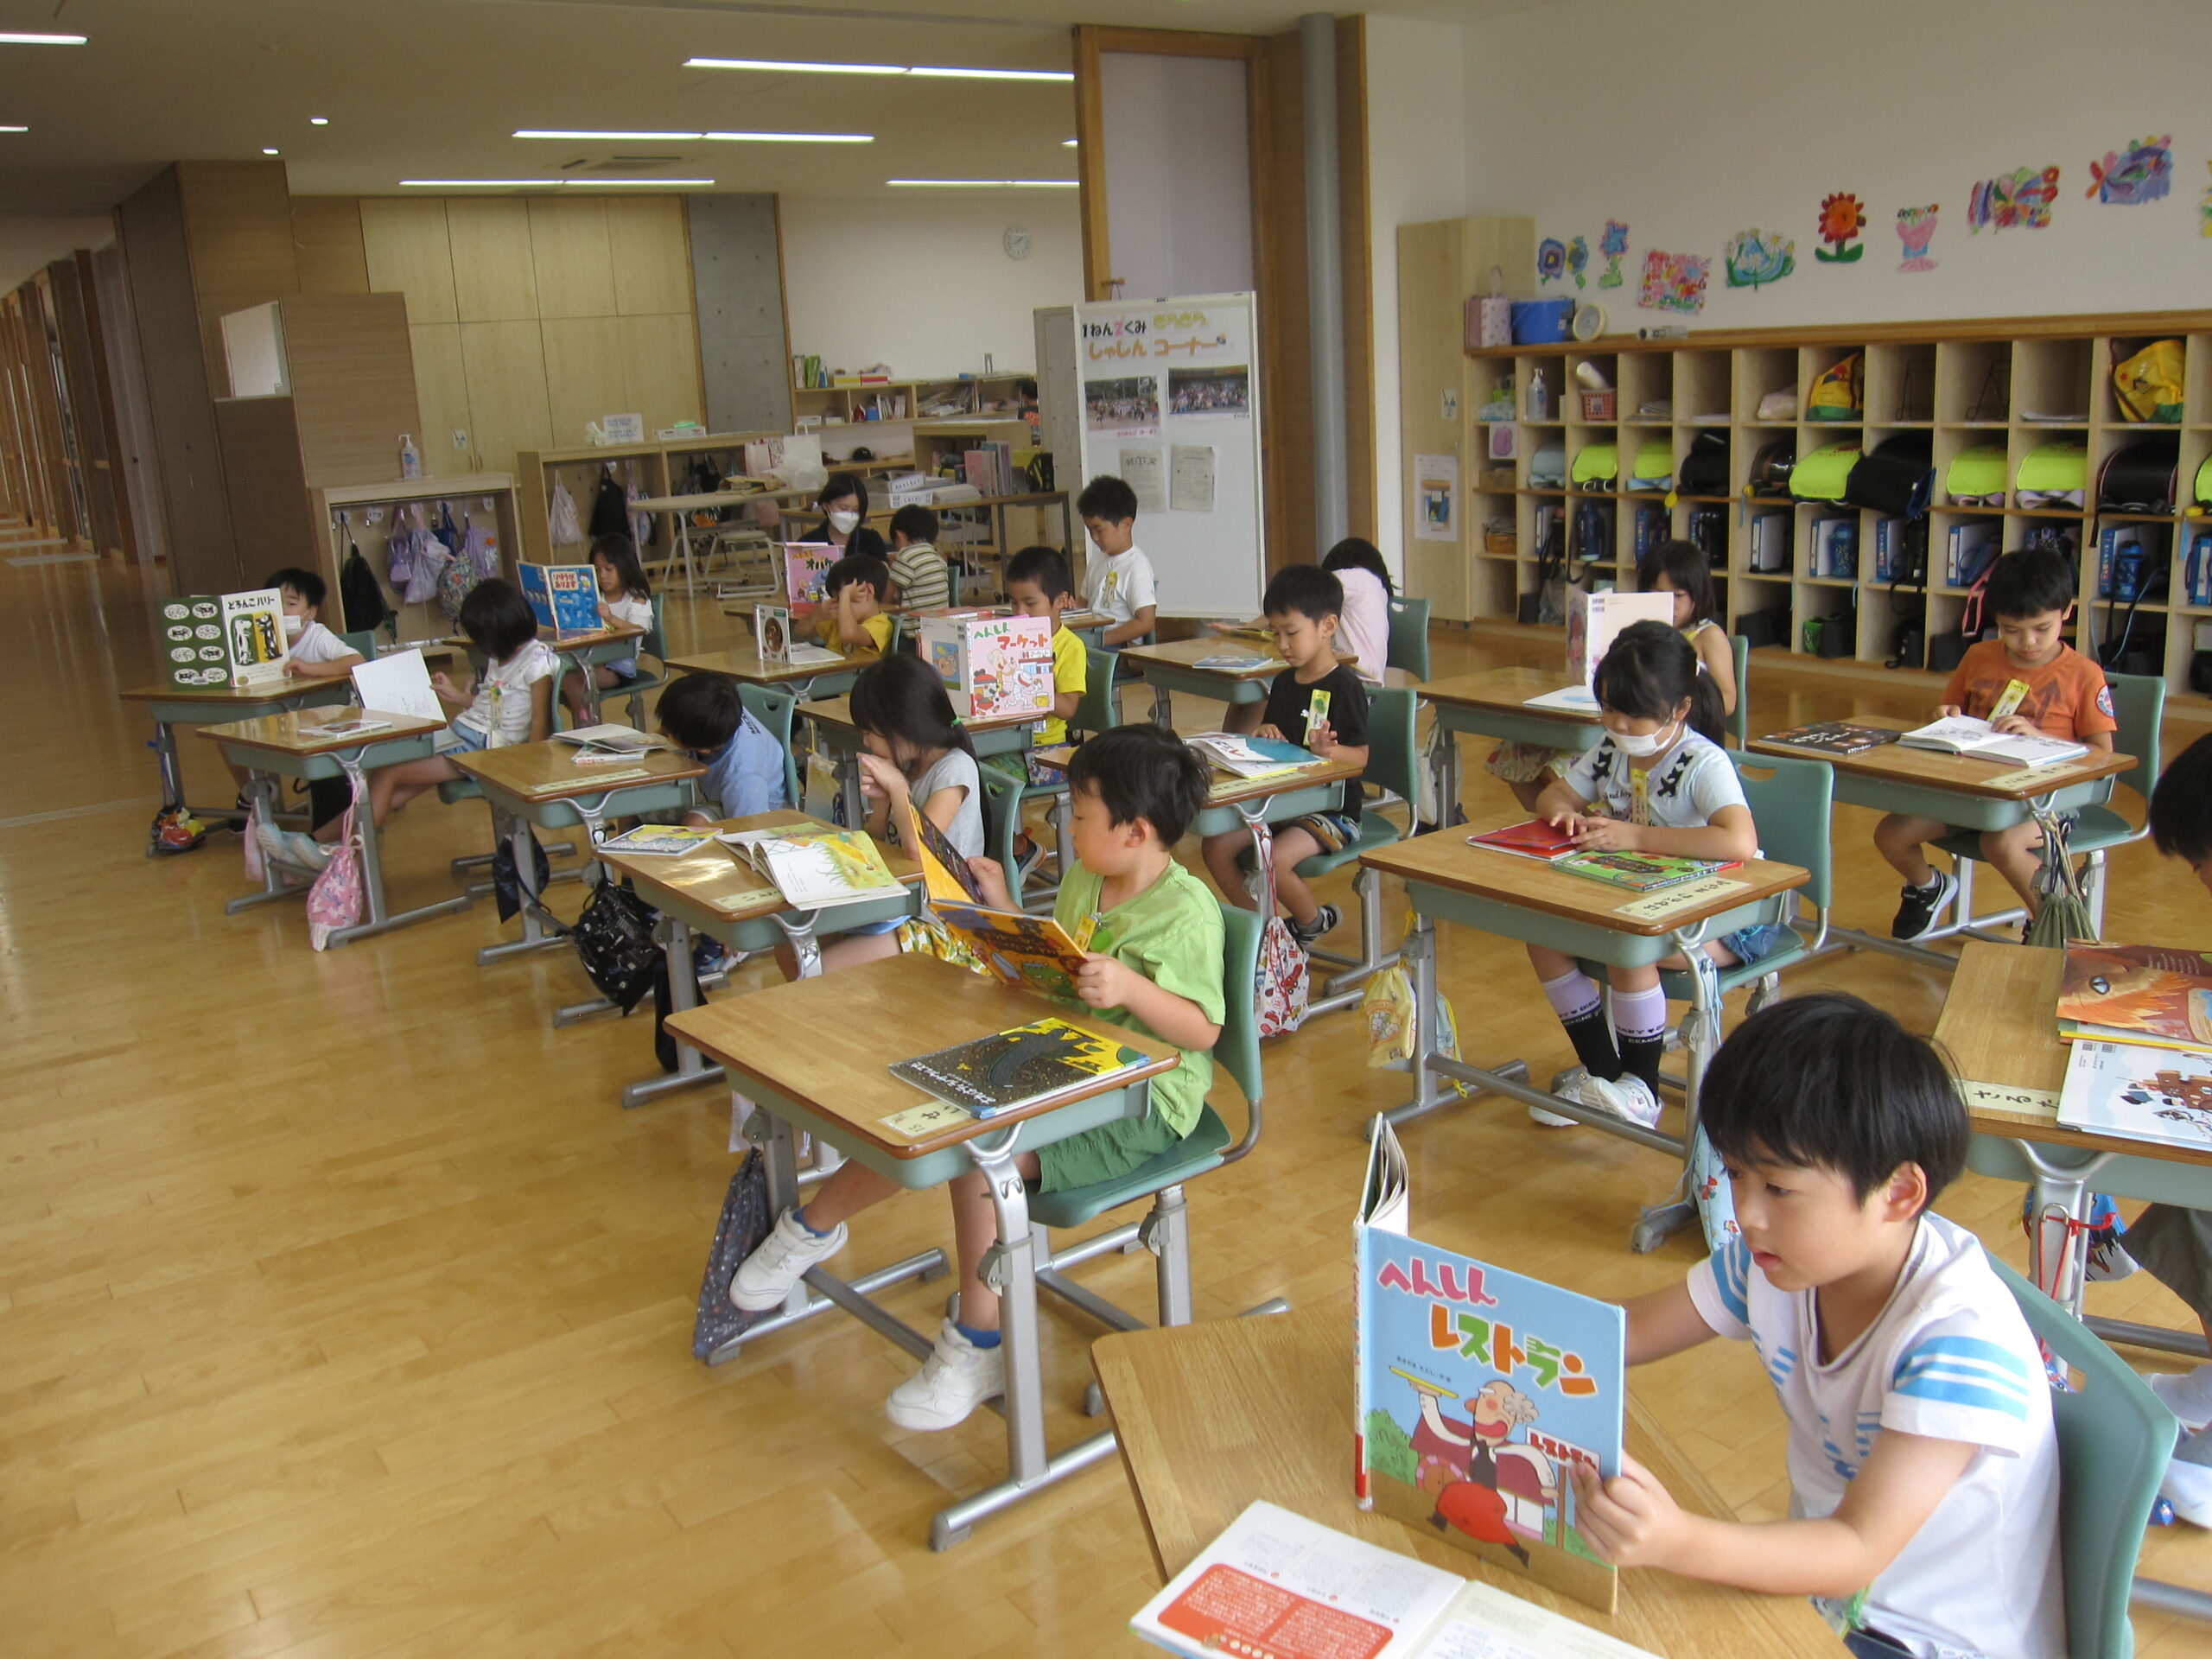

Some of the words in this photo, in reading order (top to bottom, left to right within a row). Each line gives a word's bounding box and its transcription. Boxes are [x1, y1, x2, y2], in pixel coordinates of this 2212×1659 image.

[1083, 320, 1147, 338] 1ねん2くみ
[1089, 338, 1147, 359] しゃしん
[1154, 336, 1218, 356] コーナー
[228, 596, 275, 610] どろんこハリー
[973, 621, 1011, 639] へんしん
[996, 632, 1049, 650] マーケット
[1377, 1257, 1497, 1307] へんしん
[1430, 1302, 1598, 1395] レストラン
